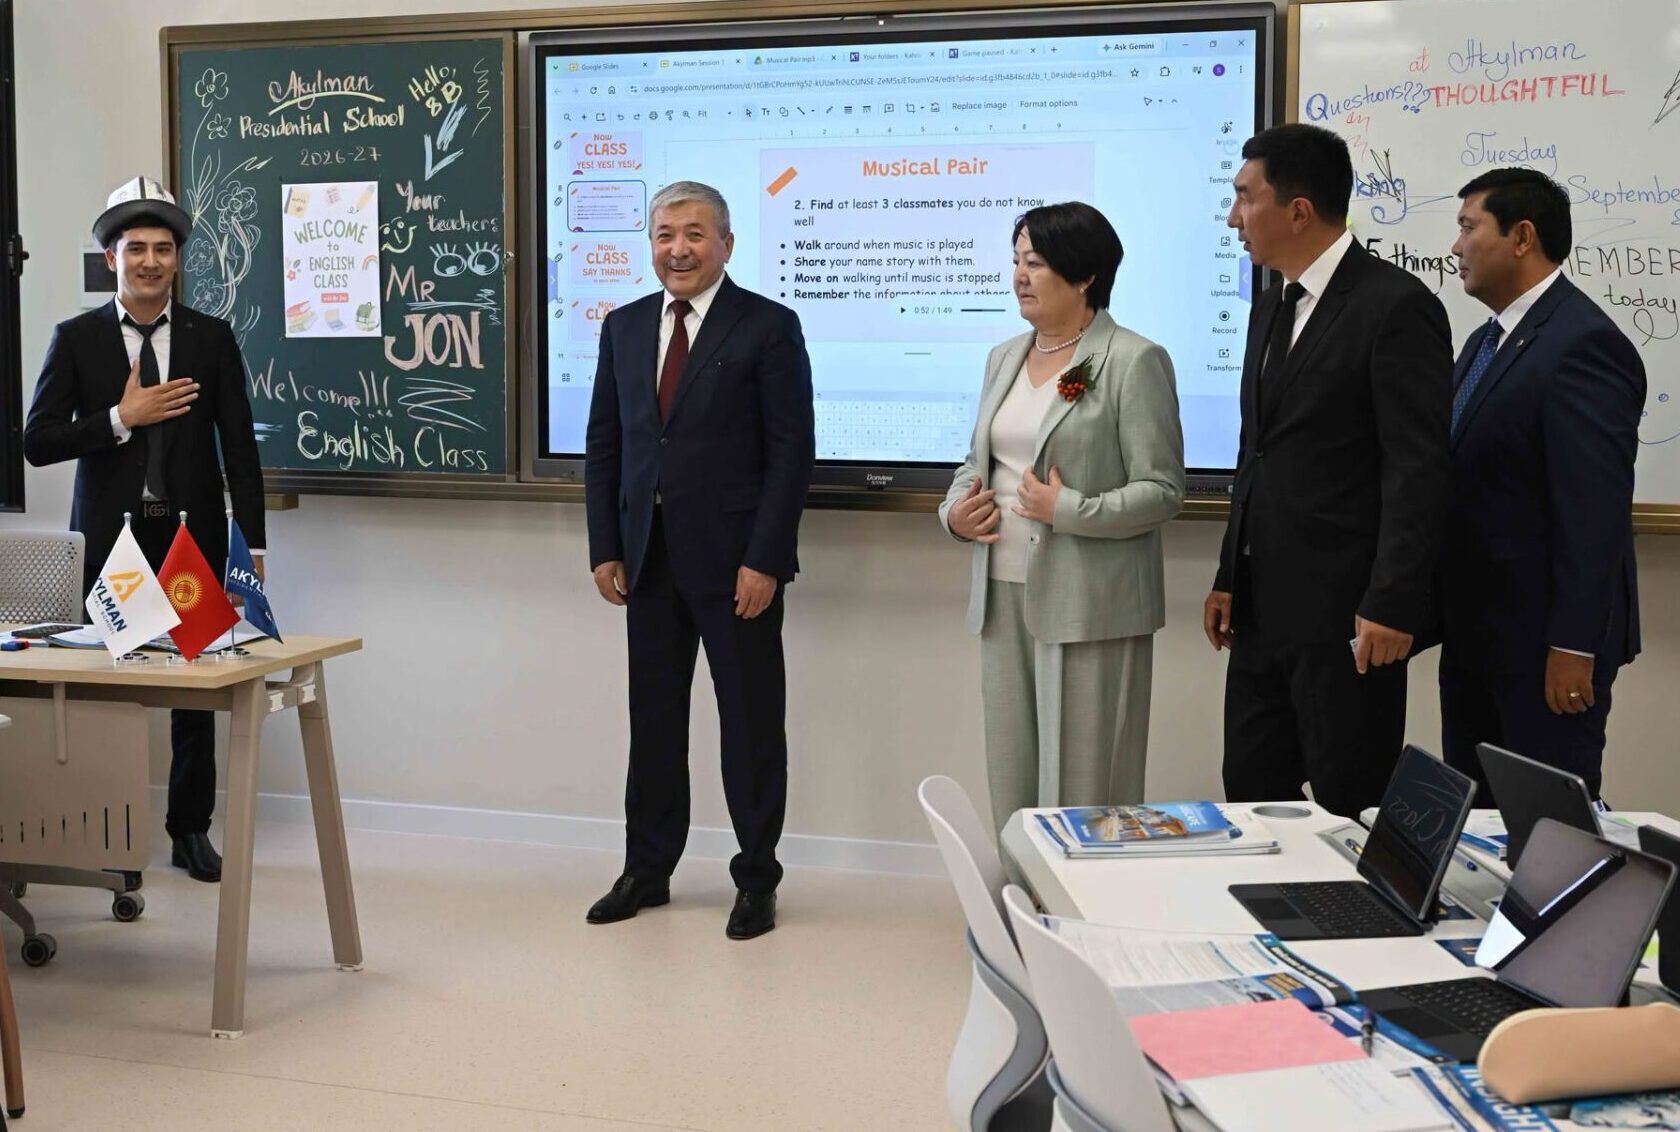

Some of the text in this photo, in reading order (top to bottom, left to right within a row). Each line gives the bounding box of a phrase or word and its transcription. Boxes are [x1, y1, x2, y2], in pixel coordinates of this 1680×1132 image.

[766, 56, 788, 64] Musical
[1408, 46, 1431, 74] at
[581, 63, 619, 72] Google Slides
[268, 69, 374, 111] Akylman
[1430, 73, 1626, 108] THOUGHTFUL
[698, 99, 1078, 118] Fit Replace image Format options
[239, 104, 405, 140] Presidential School
[593, 133, 612, 141] Now
[584, 143, 627, 156] CLASS
[1460, 132, 1558, 173] Tuesday
[300, 147, 382, 167] 2026-27
[577, 159, 635, 169] YES! YES! YES!
[863, 157, 989, 176] Musical Pair
[396, 180, 446, 213] Your
[1566, 174, 1680, 215] Septembe
[794, 196, 1045, 210] 2. Find at least 3 classmates you do not know
[794, 216, 815, 226] well
[294, 218, 369, 245] WELCOME
[327, 242, 340, 253] to
[597, 243, 616, 251] Now
[794, 238, 974, 251] Walk around when music is played
[309, 257, 355, 271] ENGLISH
[586, 252, 629, 264] CLASS
[794, 255, 976, 269] Share your name story with them.
[1567, 245, 1680, 278] EMBER
[582, 268, 631, 276] SAY THANKS
[794, 271, 1000, 285] Move on walking until music is stopped
[313, 274, 348, 289] CLASS
[794, 289, 850, 300] Remember
[853, 289, 871, 299] the
[598, 301, 616, 309] Now
[586, 308, 609, 320] CLA
[384, 311, 484, 371] JON
[297, 411, 488, 471] English Class
[230, 567, 265, 594] AKYL
[94, 578, 127, 632] YLMAN
